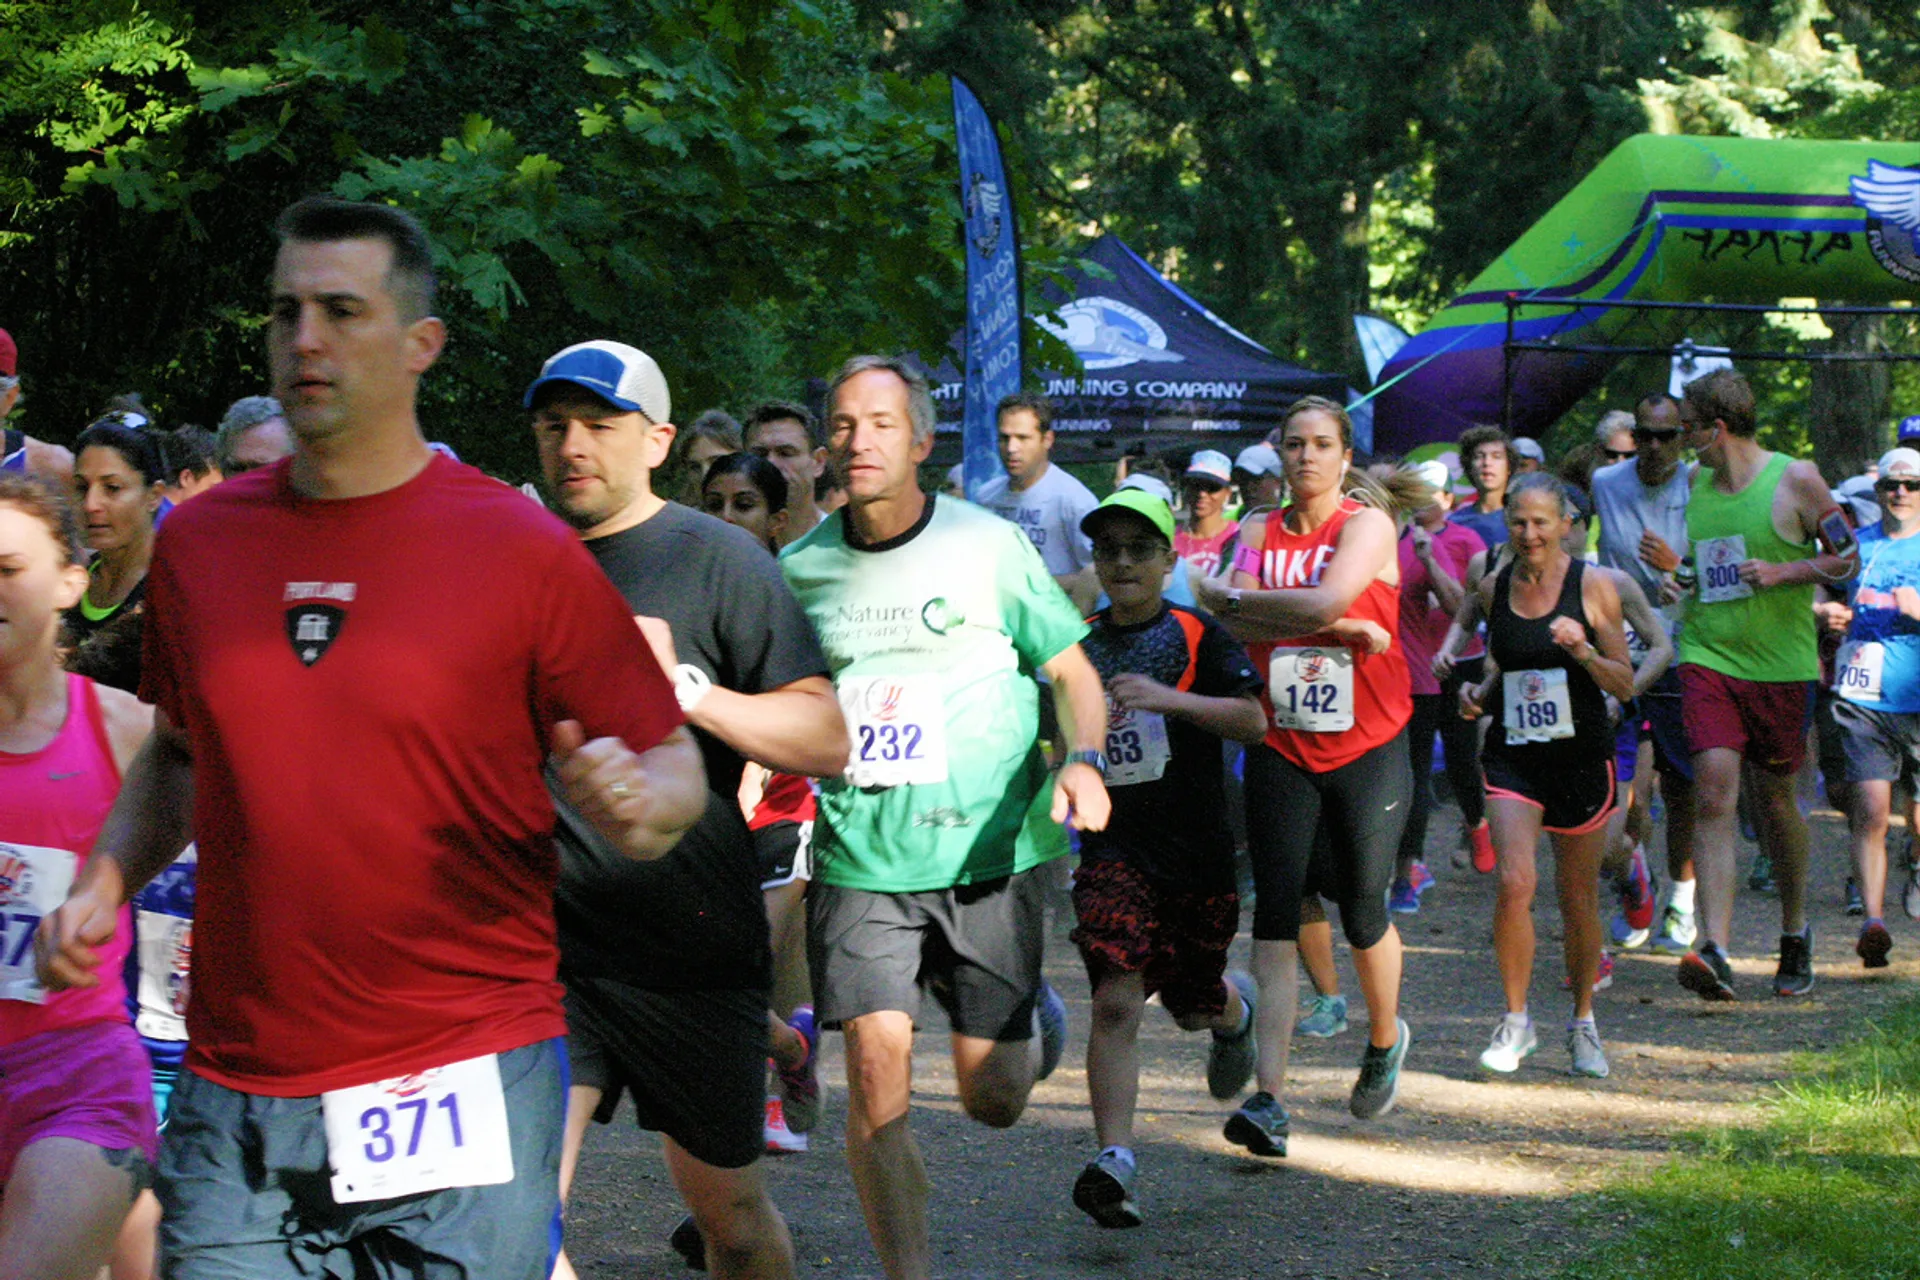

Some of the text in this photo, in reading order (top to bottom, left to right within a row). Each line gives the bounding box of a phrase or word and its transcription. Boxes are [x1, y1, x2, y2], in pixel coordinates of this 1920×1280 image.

[1041, 378, 1247, 398] UNNING COMPANY
[1706, 564, 1740, 588] 300
[838, 603, 914, 622] Nature
[1838, 664, 1870, 689] 205
[1285, 684, 1338, 713] 142
[1515, 701, 1557, 729] 189
[859, 723, 925, 761] 232
[360, 1092, 463, 1163] 371
